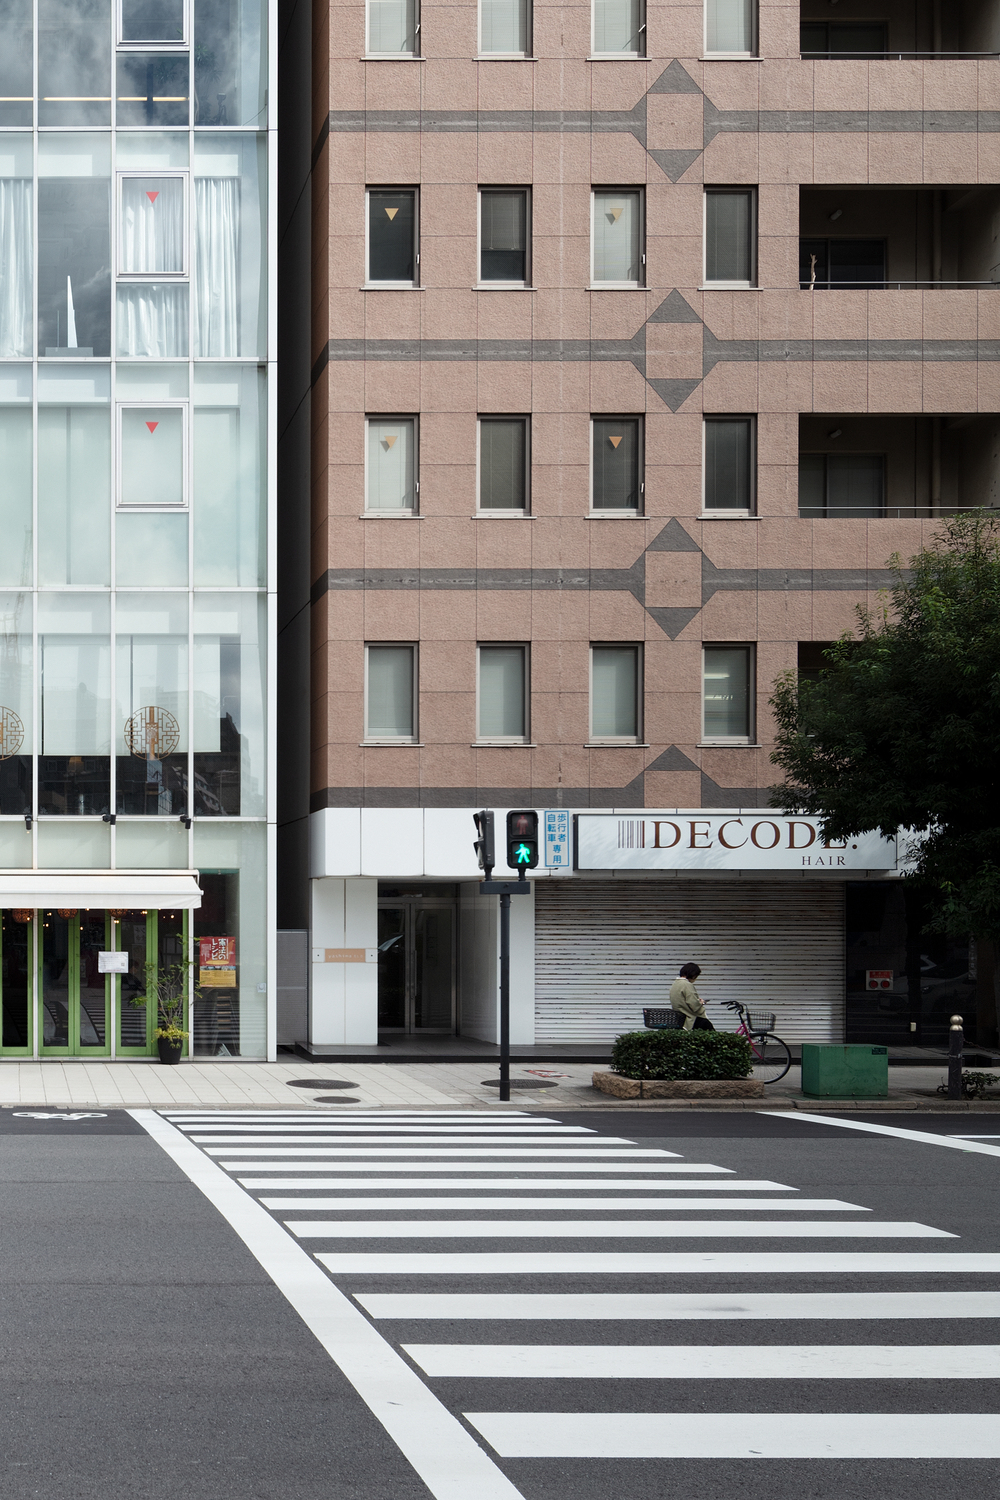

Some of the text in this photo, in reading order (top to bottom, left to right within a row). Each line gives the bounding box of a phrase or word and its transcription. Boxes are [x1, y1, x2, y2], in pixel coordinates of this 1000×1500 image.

[547, 813, 557, 843] 自転車
[558, 813, 567, 843] 歩行者
[650, 818, 858, 850] DECOD.
[553, 844, 562, 864] 専用
[801, 856, 846, 866] HAIR
